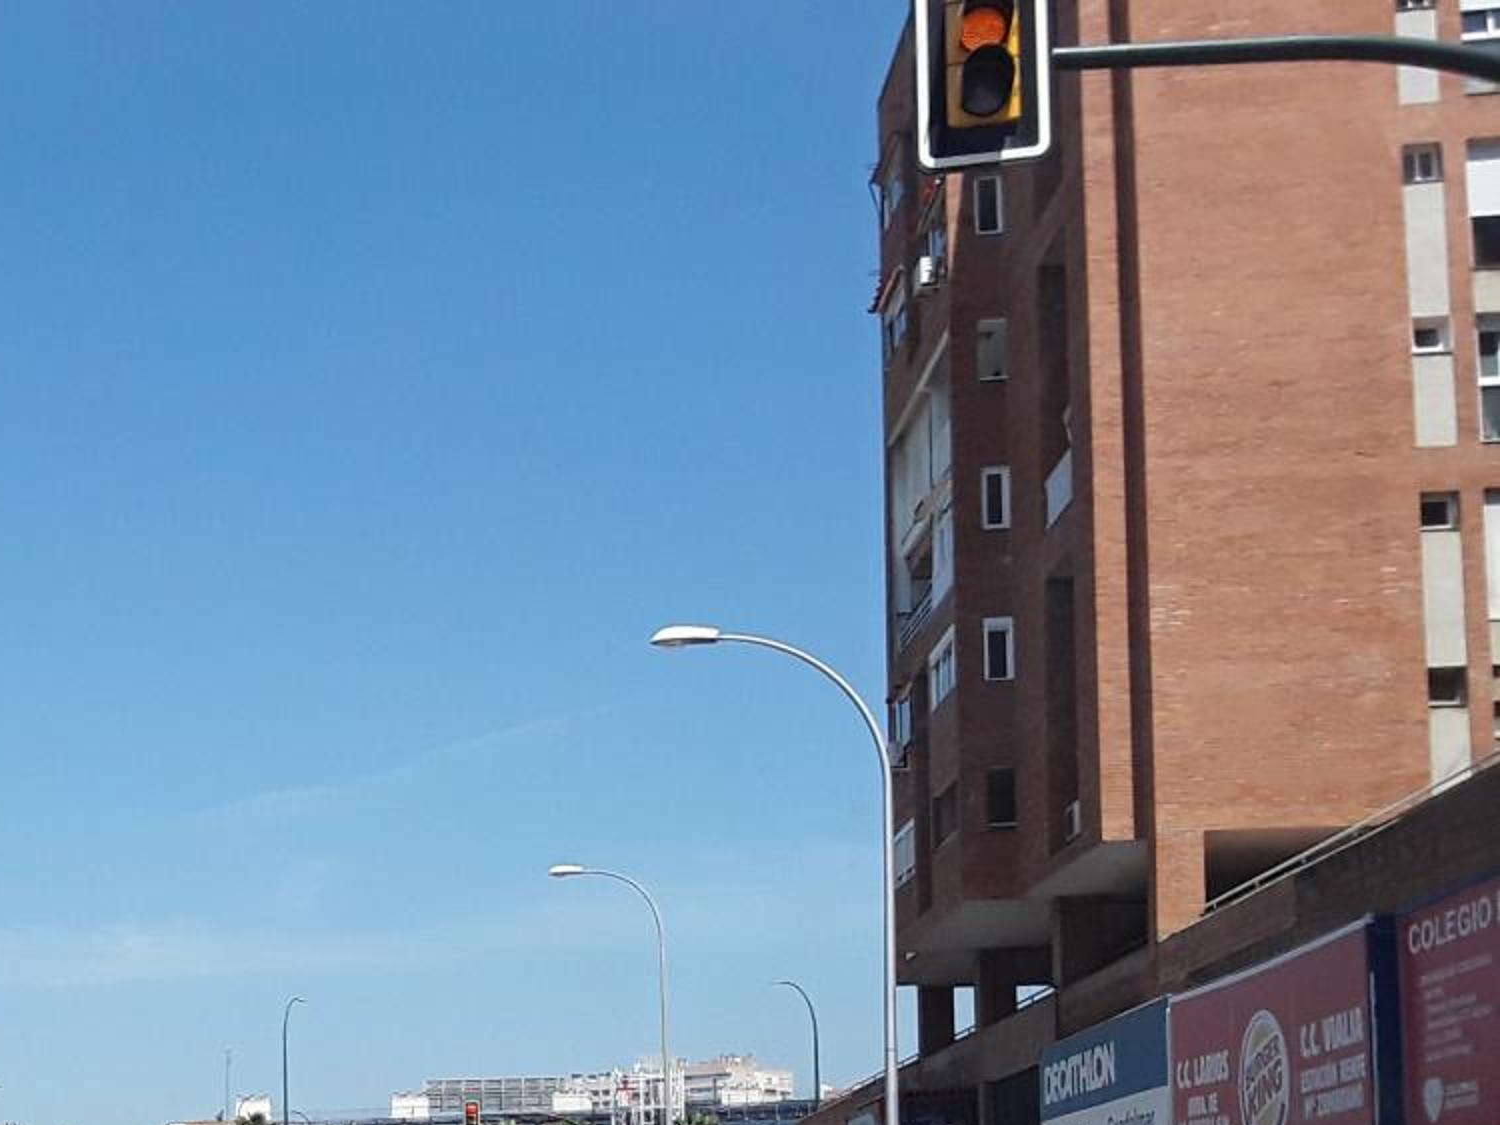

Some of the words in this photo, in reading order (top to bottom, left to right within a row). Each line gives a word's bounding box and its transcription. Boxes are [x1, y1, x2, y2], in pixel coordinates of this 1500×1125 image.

[1409, 896, 1491, 953] COLEGIO
[1044, 1041, 1115, 1105] DECATHLON
[1247, 1058, 1282, 1118] KING
